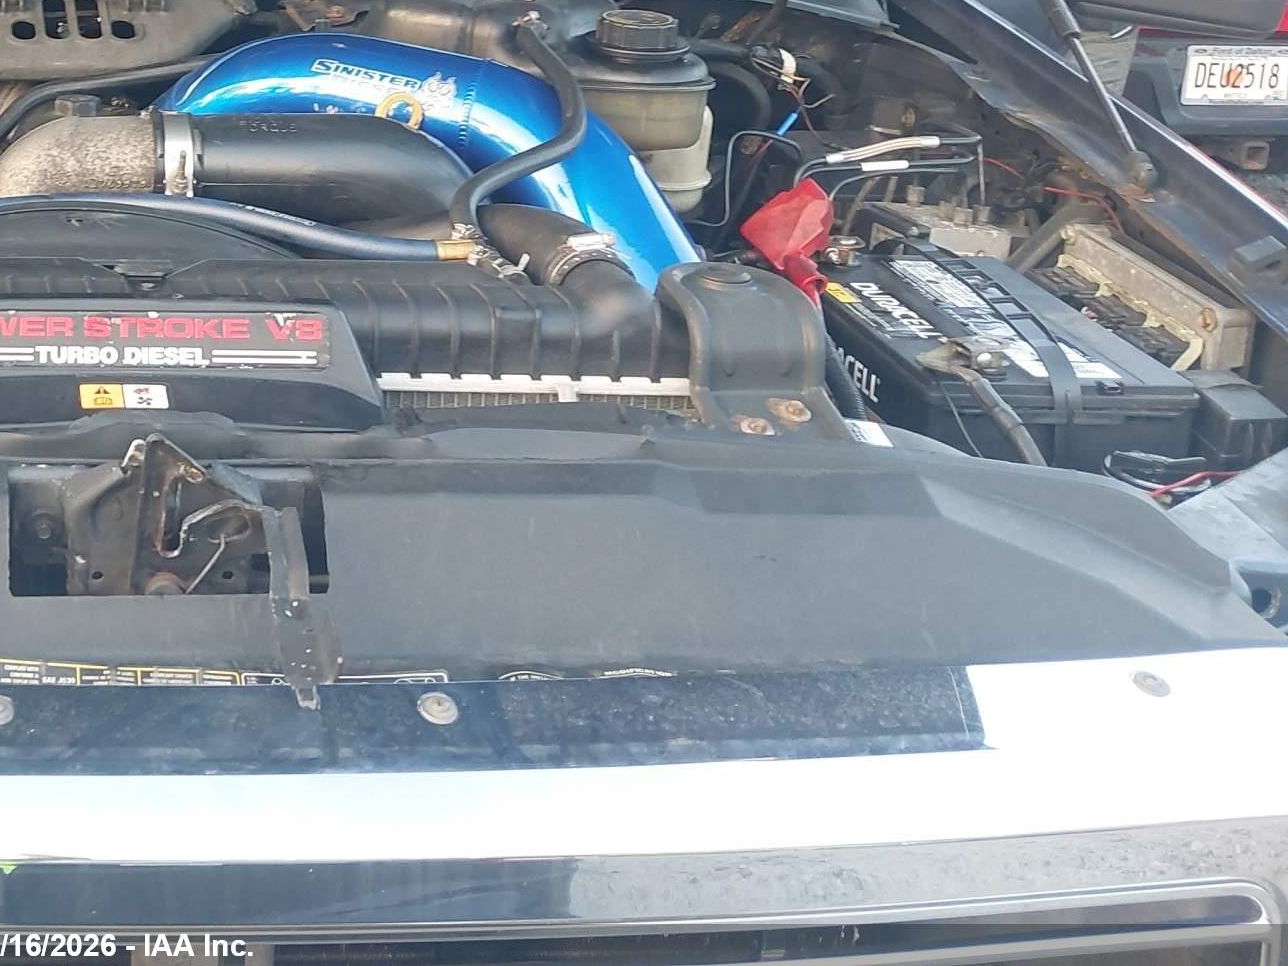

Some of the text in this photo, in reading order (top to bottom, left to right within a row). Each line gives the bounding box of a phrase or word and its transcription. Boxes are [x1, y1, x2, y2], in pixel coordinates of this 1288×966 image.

[312, 60, 420, 91] SINISTER
[1194, 62, 1280, 89] DEU2518
[849, 282, 943, 339] DURACELL
[83, 315, 251, 340] STROKE
[265, 318, 324, 341] V8
[35, 346, 210, 366] TURBO DIESEL
